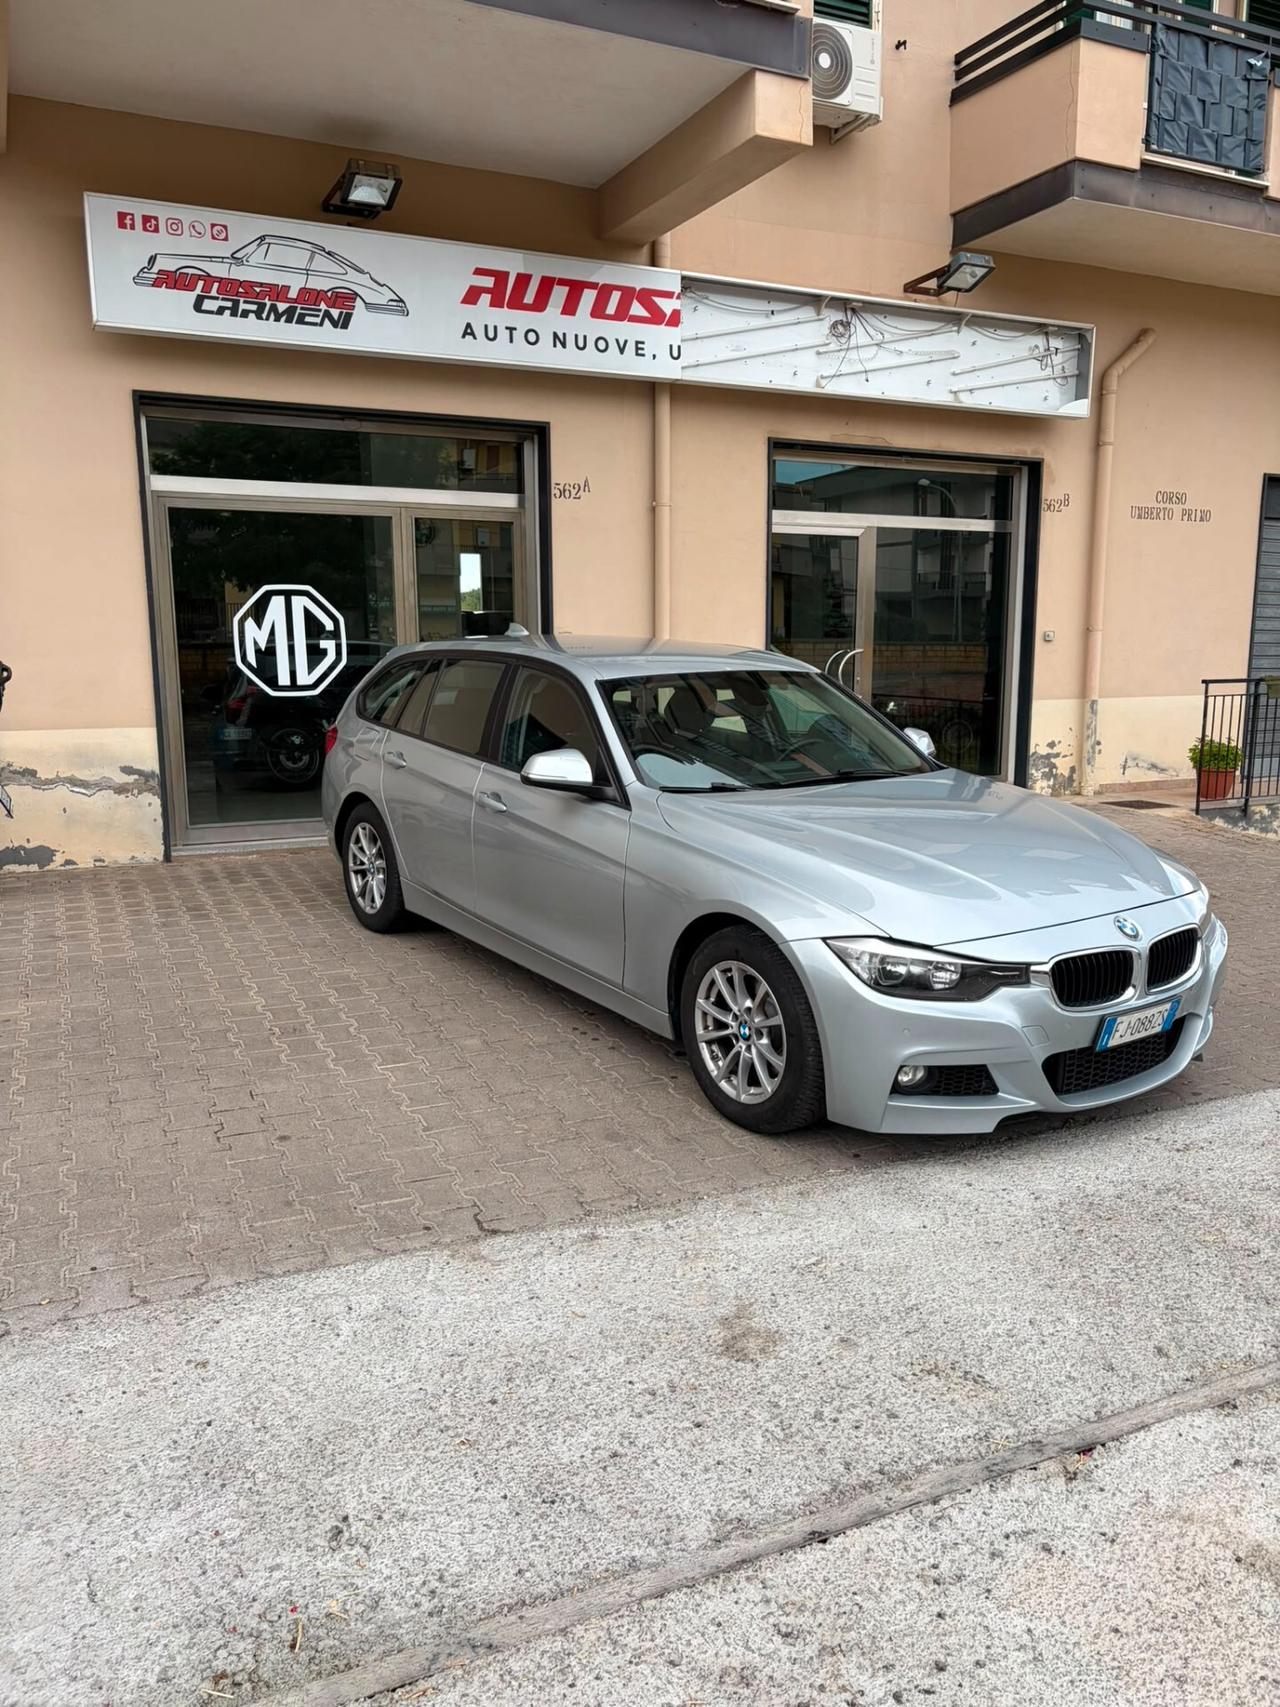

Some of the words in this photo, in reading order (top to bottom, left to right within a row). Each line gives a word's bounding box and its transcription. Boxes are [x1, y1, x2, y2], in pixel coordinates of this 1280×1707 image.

[152, 269, 358, 311] AUTOSALONE
[192, 293, 354, 330] CARMENI
[461, 321, 541, 346] AUTO
[552, 331, 657, 360] NUOVE,
[1130, 505, 1174, 520] UMBERTO
[1181, 508, 1212, 522] PRIMO
[1155, 490, 1187, 505] CORSO
[244, 595, 336, 686] MG
